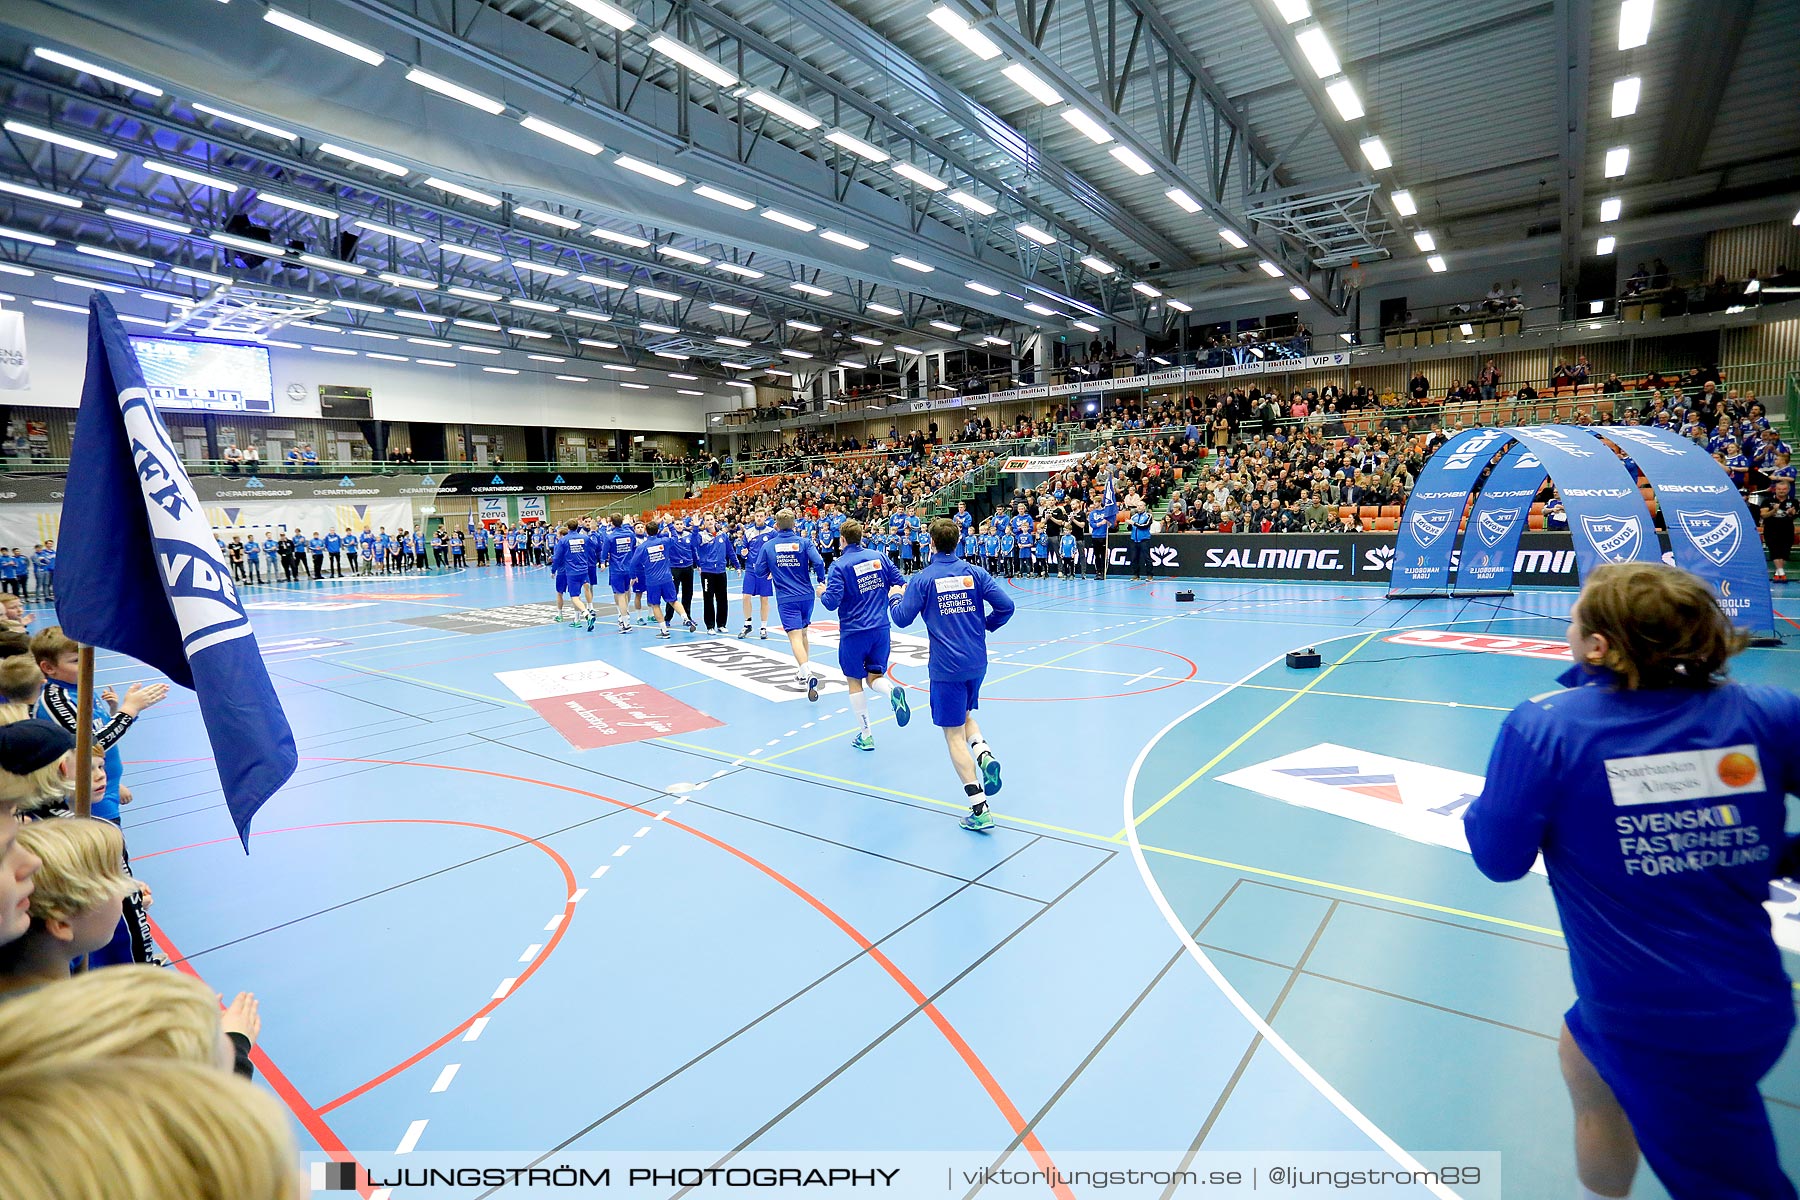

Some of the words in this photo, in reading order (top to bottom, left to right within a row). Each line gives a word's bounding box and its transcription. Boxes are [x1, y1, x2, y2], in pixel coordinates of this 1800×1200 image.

[1312, 356, 1330, 366] VIP
[320, 386, 326, 395] H
[132, 438, 193, 521] IFK
[313, 488, 380, 496] ONEPARTNERGROUP
[520, 509, 545, 517] zerva
[1688, 519, 1712, 527] IFK
[1592, 524, 1614, 533] IFK
[160, 553, 238, 606] VDE
[938, 599, 973, 610] FASTIGHETS
[1715, 599, 1751, 608] DBOLLS
[664, 641, 849, 693] FRISTADS
[1619, 825, 1760, 856] FASTIGHETS
[1624, 845, 1770, 876] FÖRMEDLING
